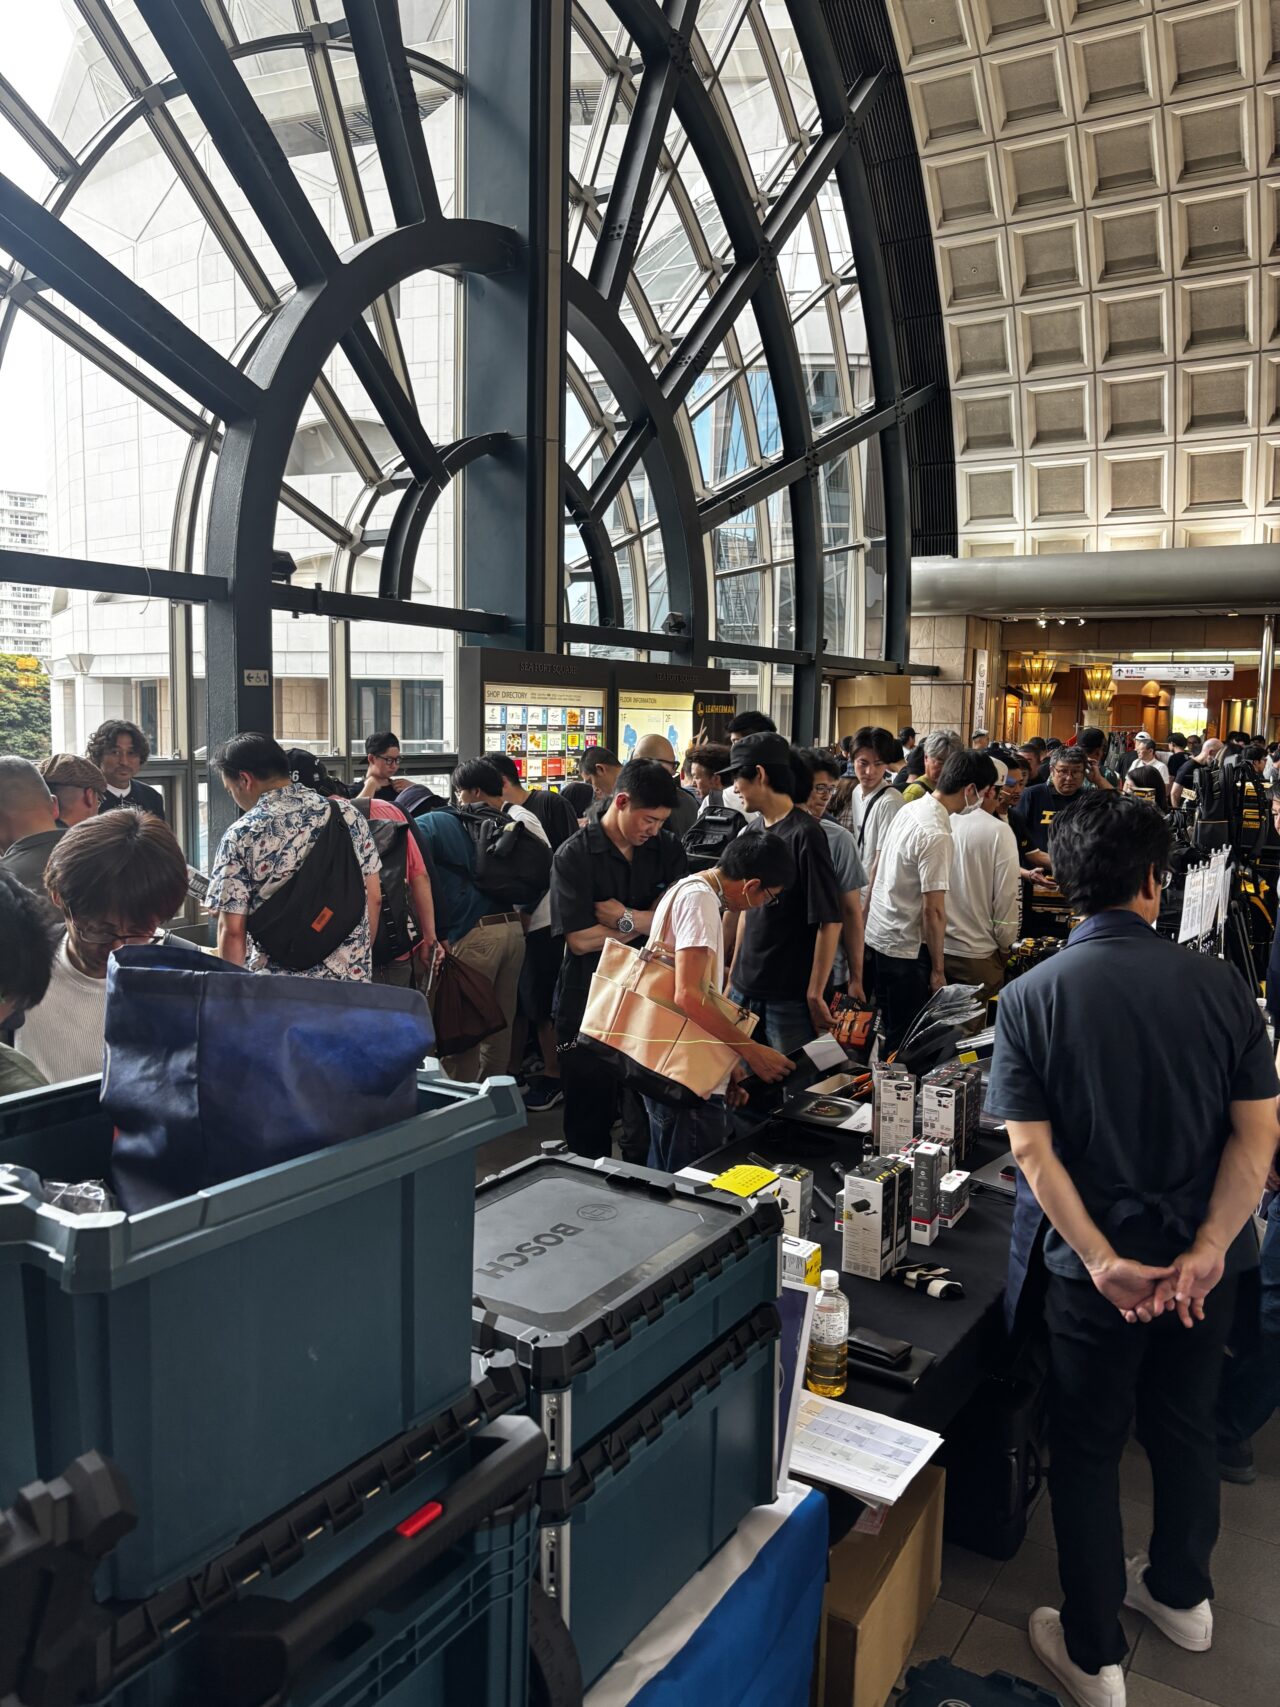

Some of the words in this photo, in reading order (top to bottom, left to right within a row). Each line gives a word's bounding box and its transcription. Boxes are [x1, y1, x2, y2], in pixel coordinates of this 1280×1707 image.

[486, 690, 499, 698] SHOP
[501, 691, 528, 699] DIRECTORY
[705, 704, 736, 714] LEATHERMAN
[475, 1223, 585, 1279] BOSCH
